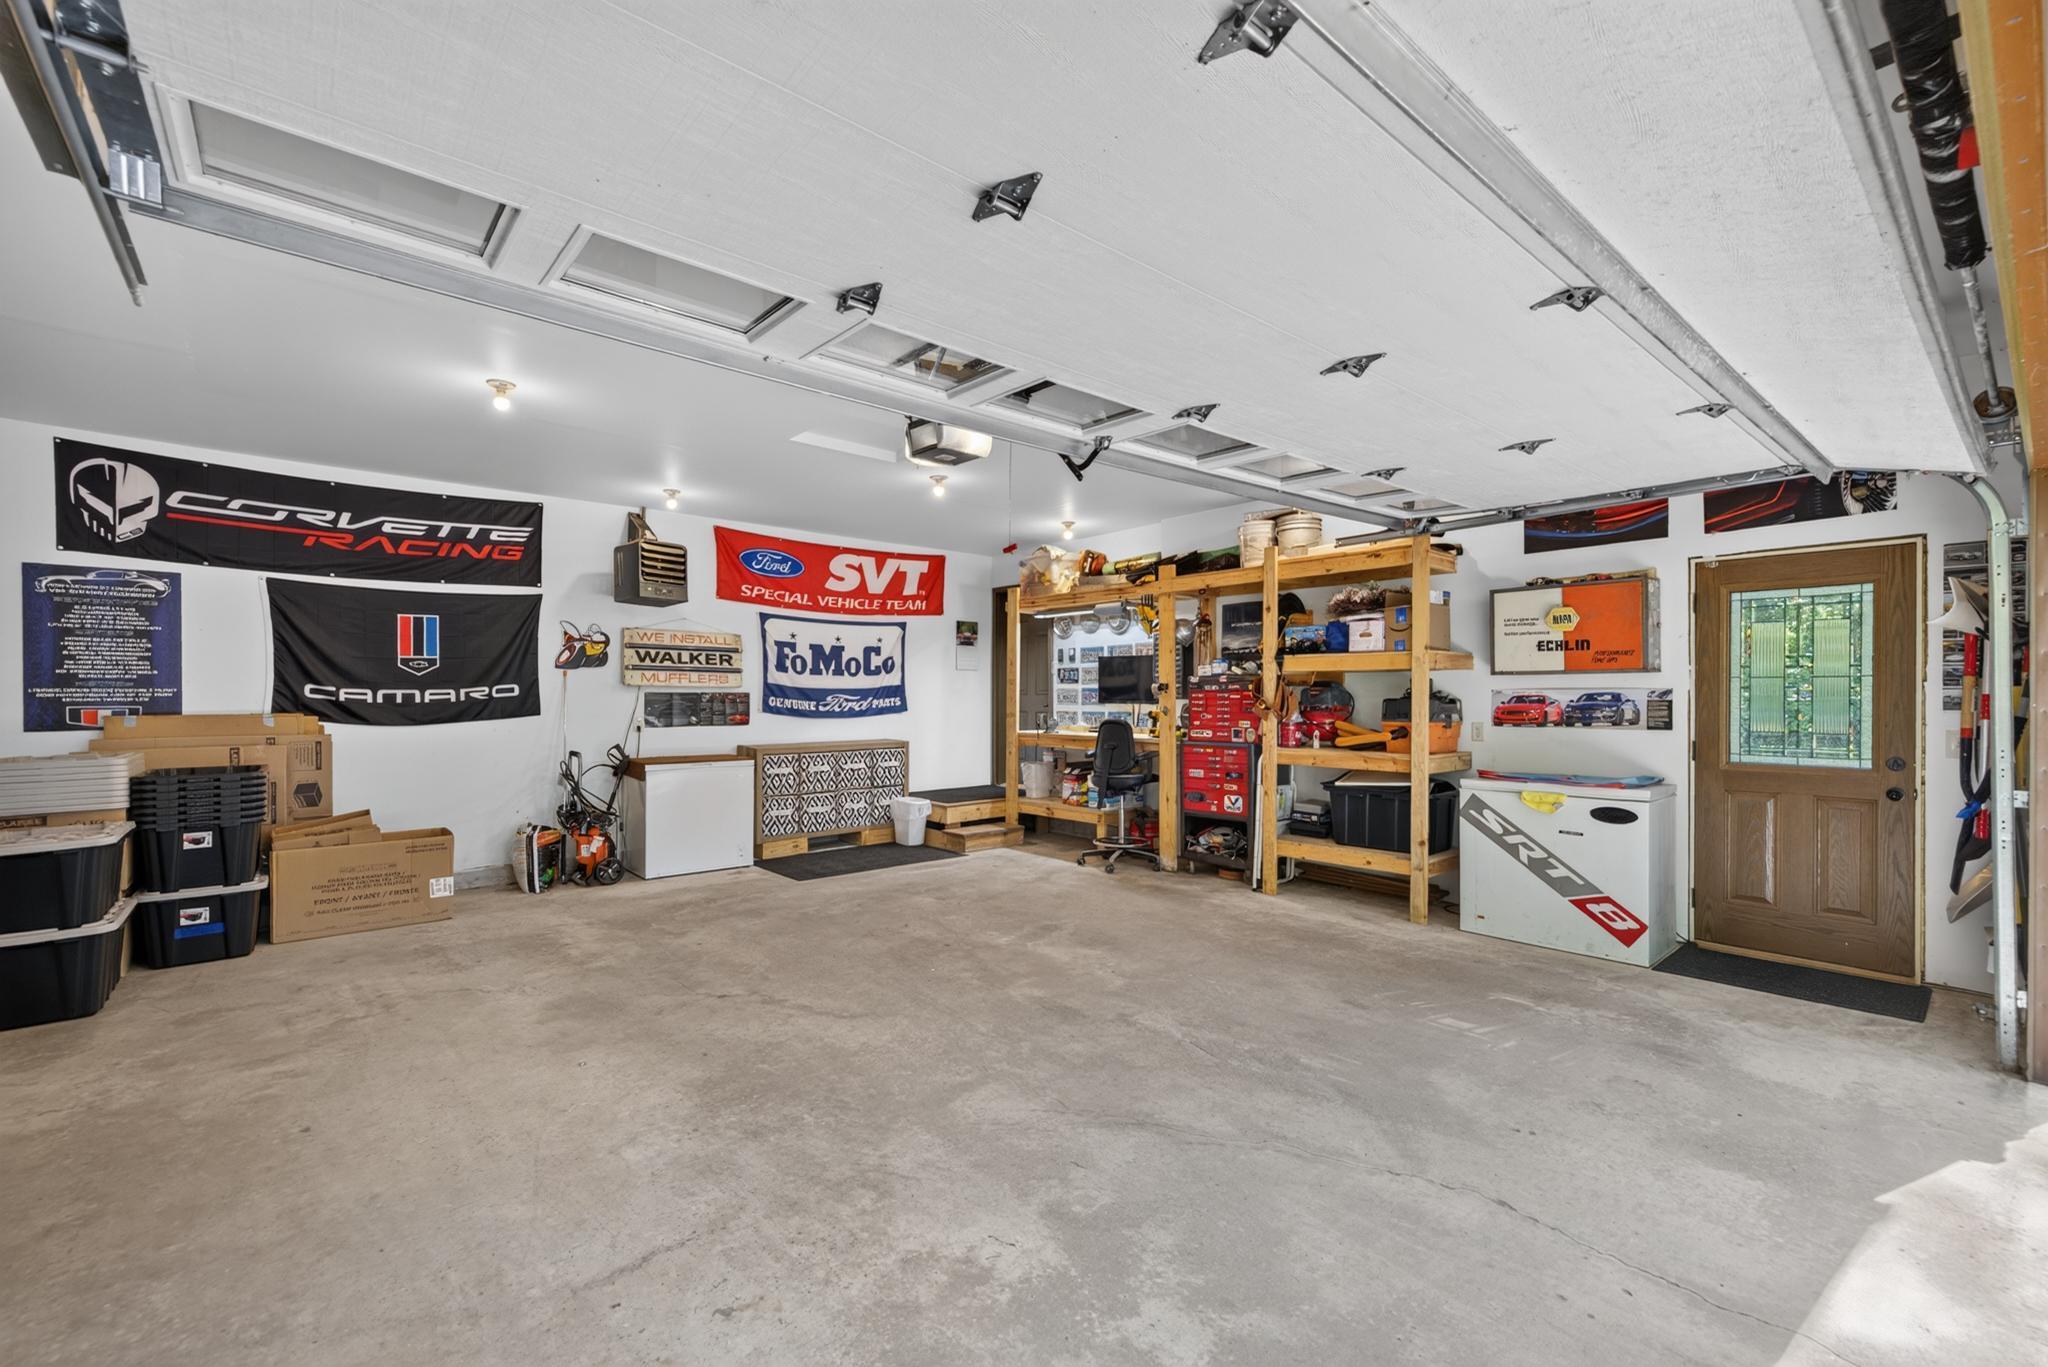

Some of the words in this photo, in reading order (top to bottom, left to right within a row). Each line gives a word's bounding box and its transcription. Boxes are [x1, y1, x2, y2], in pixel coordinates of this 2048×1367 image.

[166, 490, 535, 542] CORVETTE
[303, 532, 525, 561] RACING
[752, 553, 791, 574] Ford
[825, 553, 929, 596] SVT
[740, 584, 813, 606] SPECIAL
[817, 595, 882, 610] VEHICLE
[886, 600, 926, 610] TEAM
[637, 631, 665, 642] WE
[670, 634, 732, 646] INSTALL
[1537, 639, 1590, 652] ECHLIN
[635, 650, 733, 666] WALKER
[774, 641, 895, 677] FoMoCo
[641, 672, 729, 684] MUFFLERS
[303, 683, 520, 704] CAMARO
[768, 696, 816, 711] GENUINE
[818, 693, 873, 712] Ford
[872, 696, 902, 709] PARTS
[1469, 808, 1585, 885] SRT
[1585, 903, 1641, 931] 8
